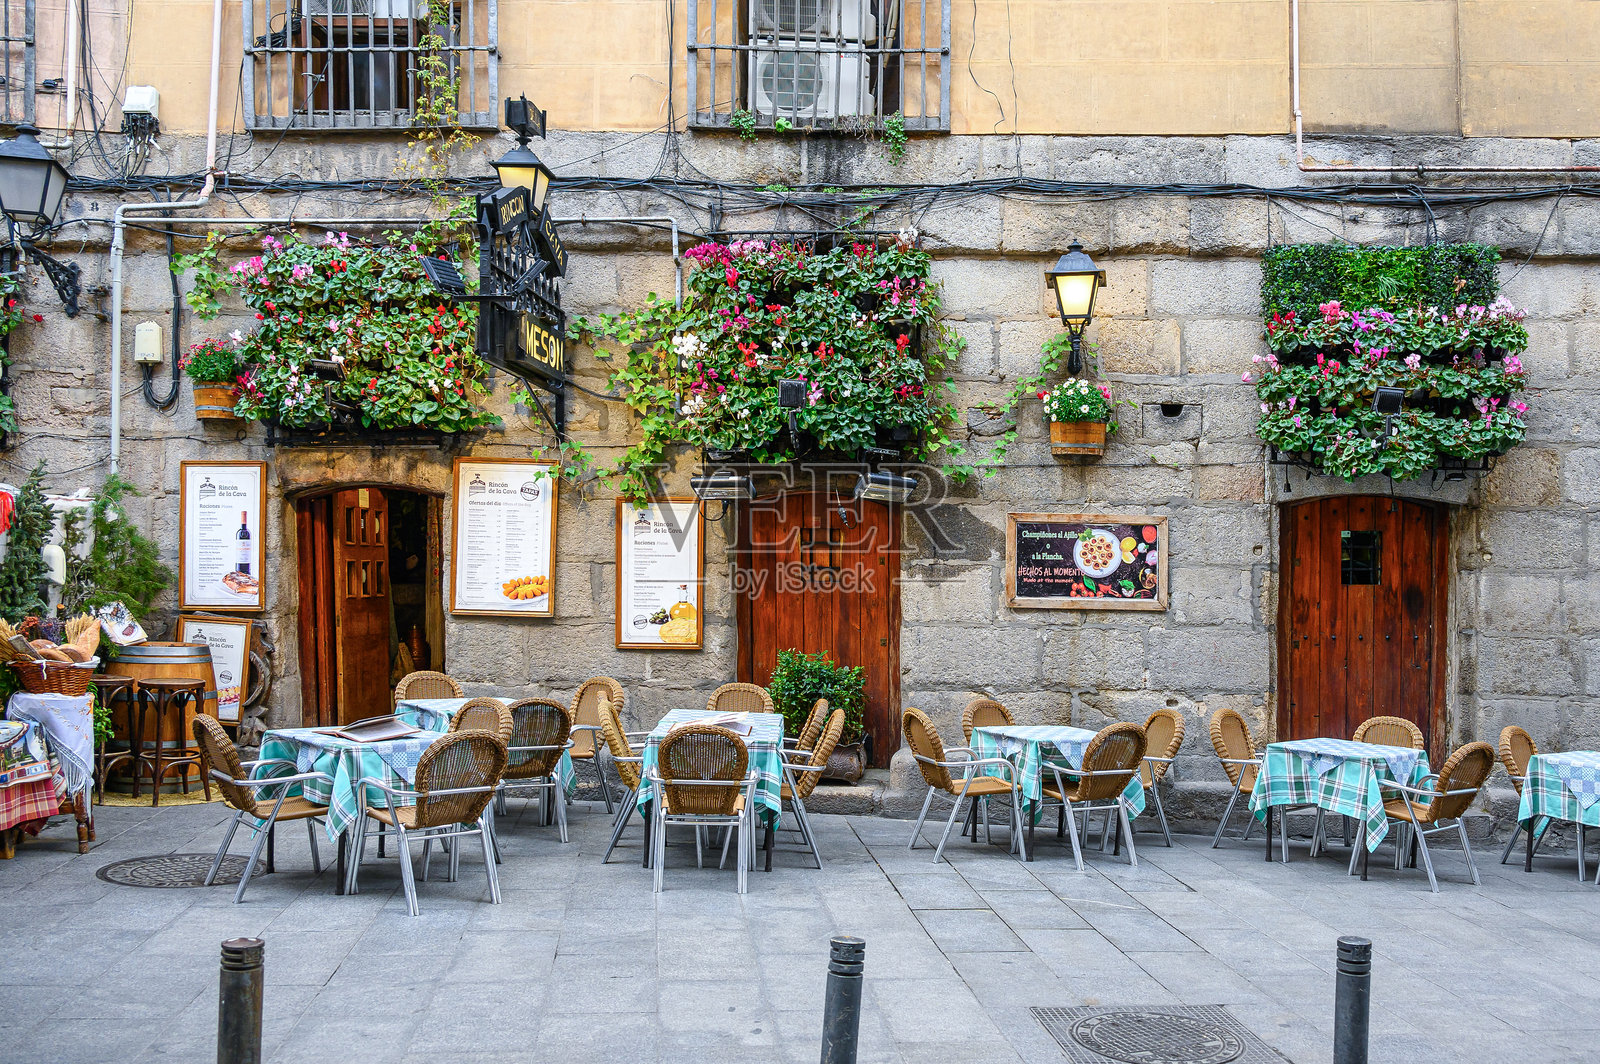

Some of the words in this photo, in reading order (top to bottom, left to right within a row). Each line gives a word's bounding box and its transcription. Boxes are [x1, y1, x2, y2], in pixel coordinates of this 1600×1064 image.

[500, 194, 524, 226] RINCON
[545, 220, 563, 266] CAVA
[526, 320, 564, 372] MESON
[1022, 531, 1057, 539] Champiñones
[1064, 531, 1078, 540] Ajillo
[1018, 565, 1043, 577] HECHOS
[1044, 567, 1052, 576] AL
